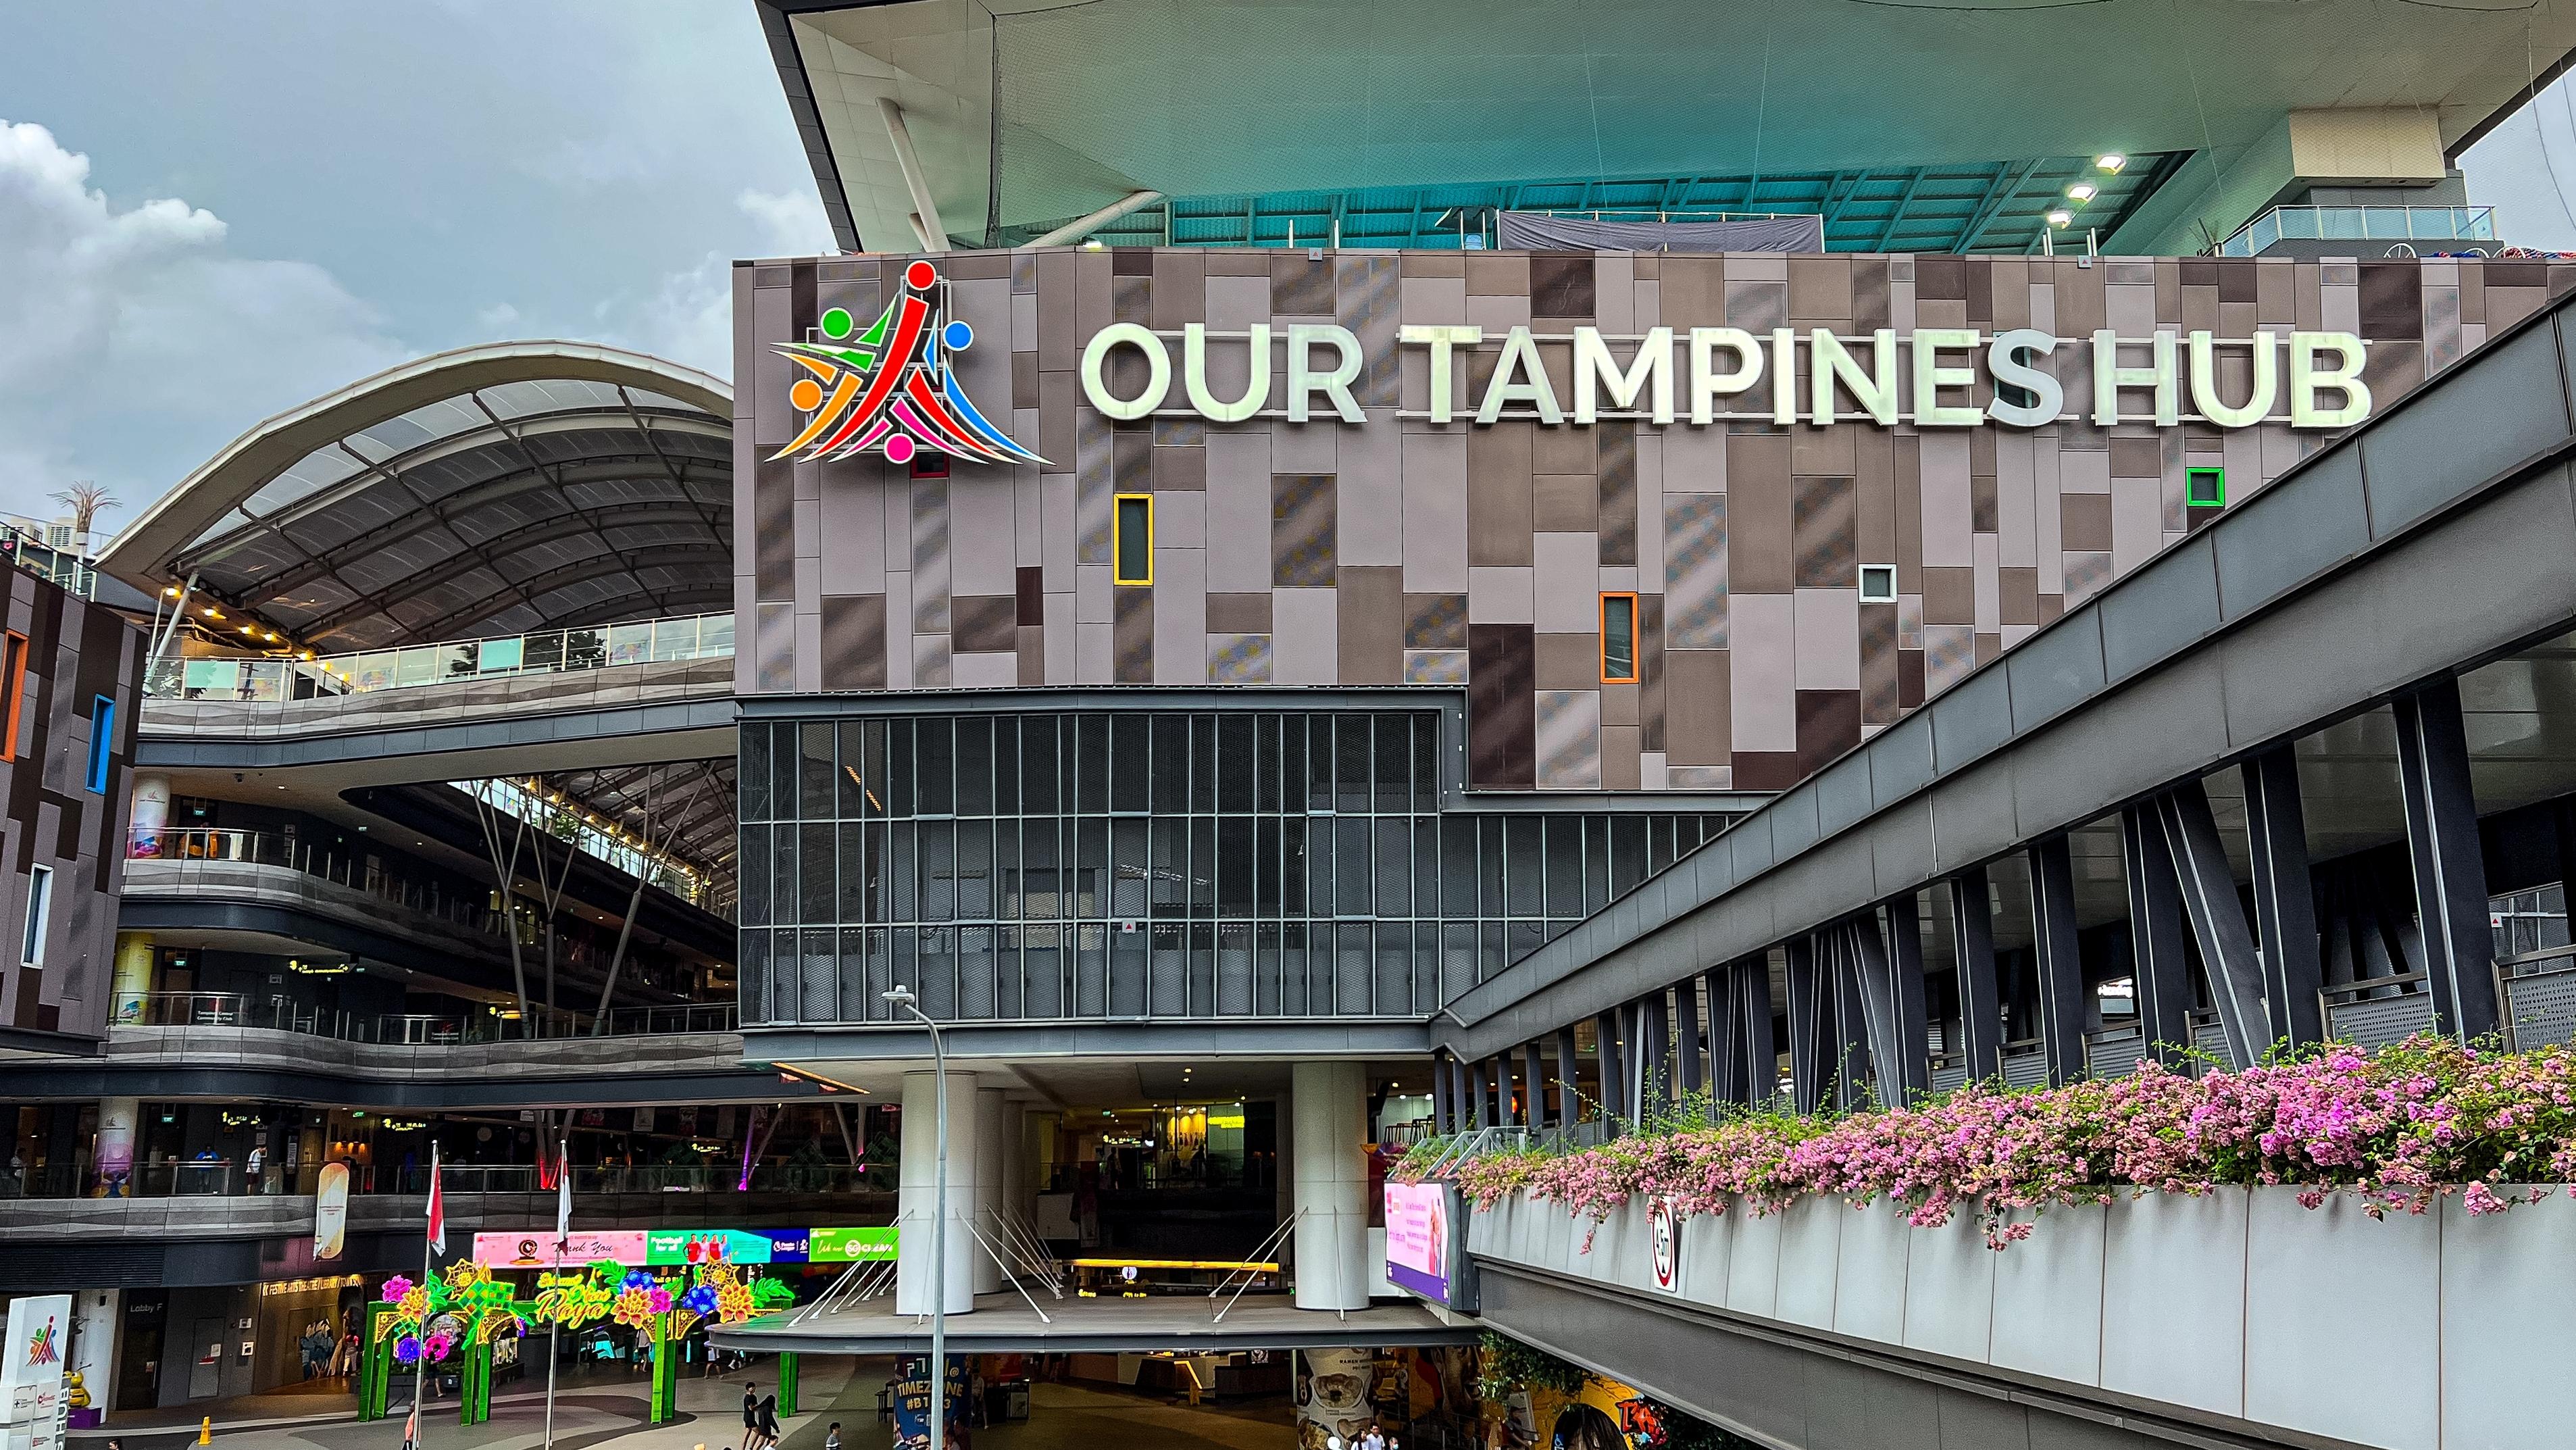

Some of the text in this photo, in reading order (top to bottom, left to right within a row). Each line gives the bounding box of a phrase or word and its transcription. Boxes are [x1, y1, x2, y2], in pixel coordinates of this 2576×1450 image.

[1081, 322, 2373, 429] OUR TAMPINES HUB
[590, 1241, 613, 1255] You
[270, 1282, 288, 1295] FESTIVE
[130, 1304, 154, 1313] Lobby
[536, 1289, 611, 1329] Raya
[897, 1380, 963, 1397] TIMEZNE
